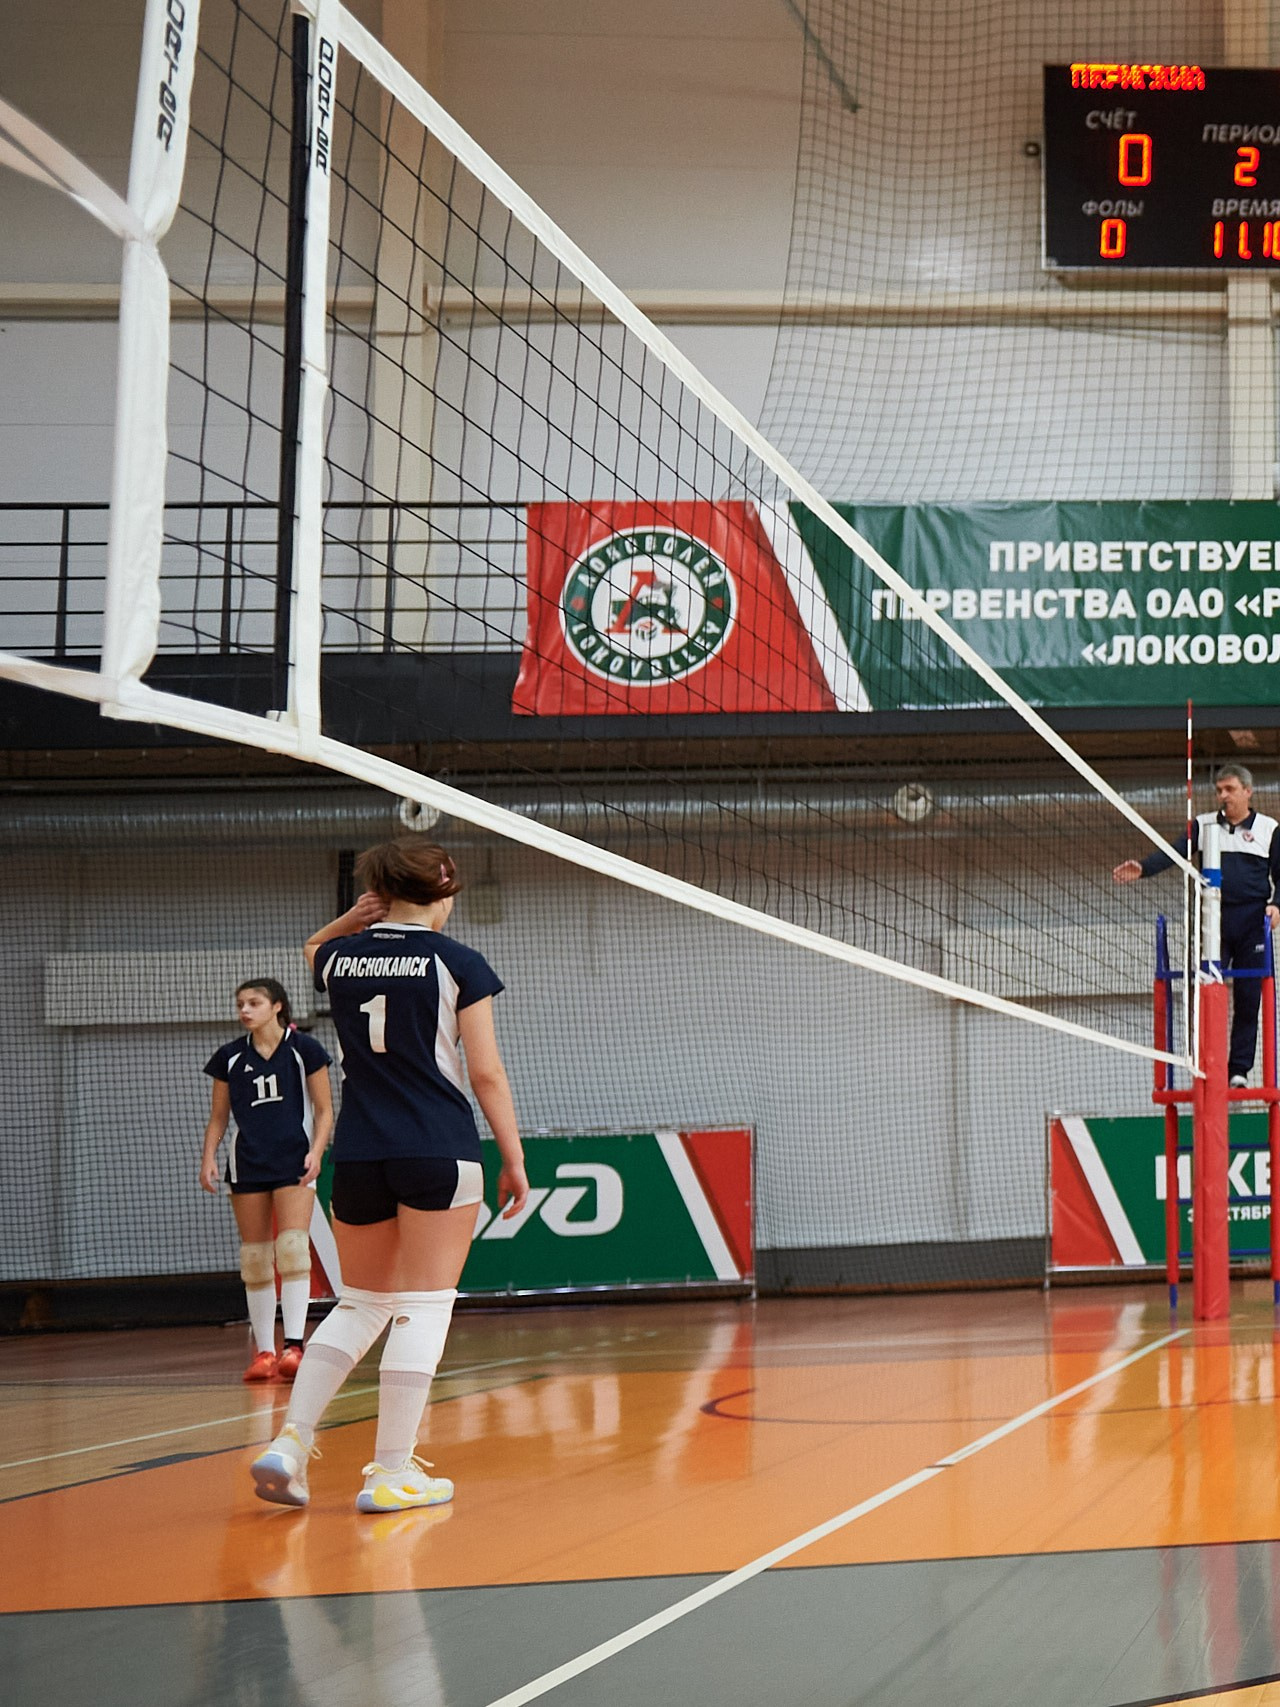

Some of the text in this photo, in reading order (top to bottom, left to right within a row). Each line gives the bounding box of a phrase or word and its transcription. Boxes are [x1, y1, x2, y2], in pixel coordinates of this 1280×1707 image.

[1086, 109, 1137, 130] СЧЁТ
[1118, 133, 1153, 187] 0
[1233, 146, 1260, 187] 2
[1081, 200, 1145, 217] ФОЛЫ
[1100, 218, 1127, 259] 0
[1146, 587, 1225, 619] ОАО
[333, 955, 431, 978] КРАСНОКАМСК
[360, 994, 387, 1053] 1
[253, 1074, 279, 1099] 11
